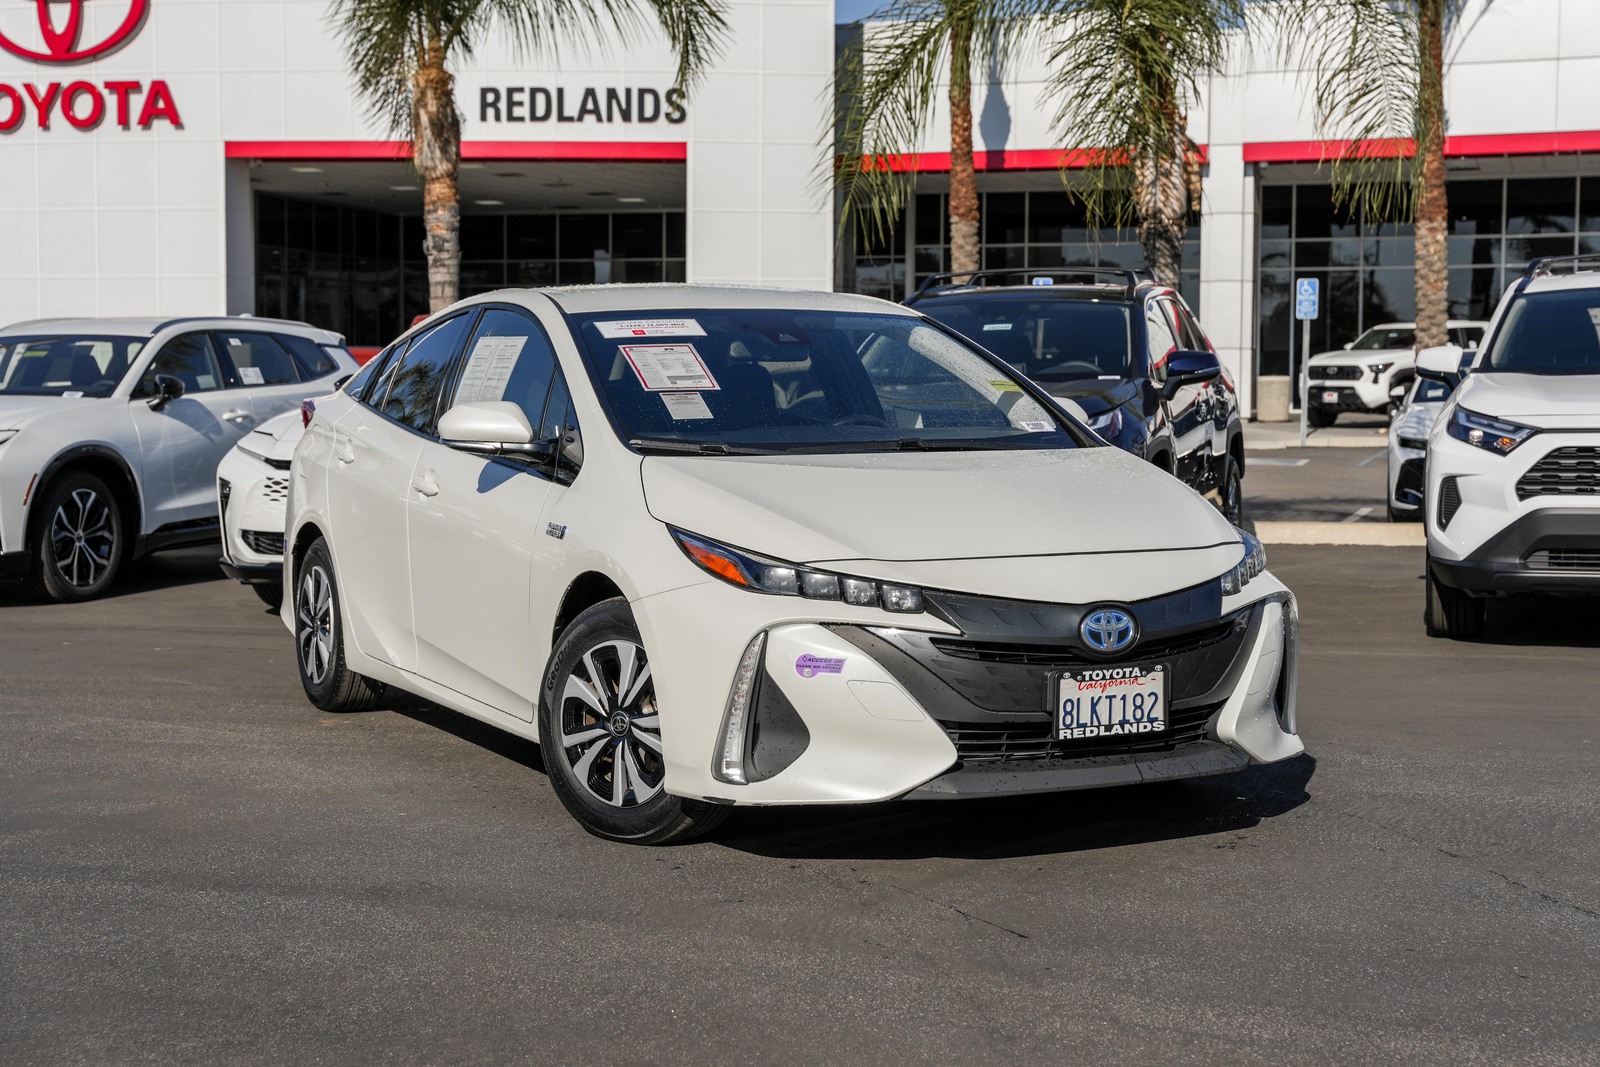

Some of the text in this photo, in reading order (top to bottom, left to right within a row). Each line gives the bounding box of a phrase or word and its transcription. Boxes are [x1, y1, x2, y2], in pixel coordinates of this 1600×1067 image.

[480, 87, 687, 124] REDLANDS
[1082, 667, 1141, 681] TOYOTA
[1077, 677, 1146, 693] California
[1062, 691, 1159, 728] 8LKT182
[1059, 721, 1166, 740] REDLANDS
